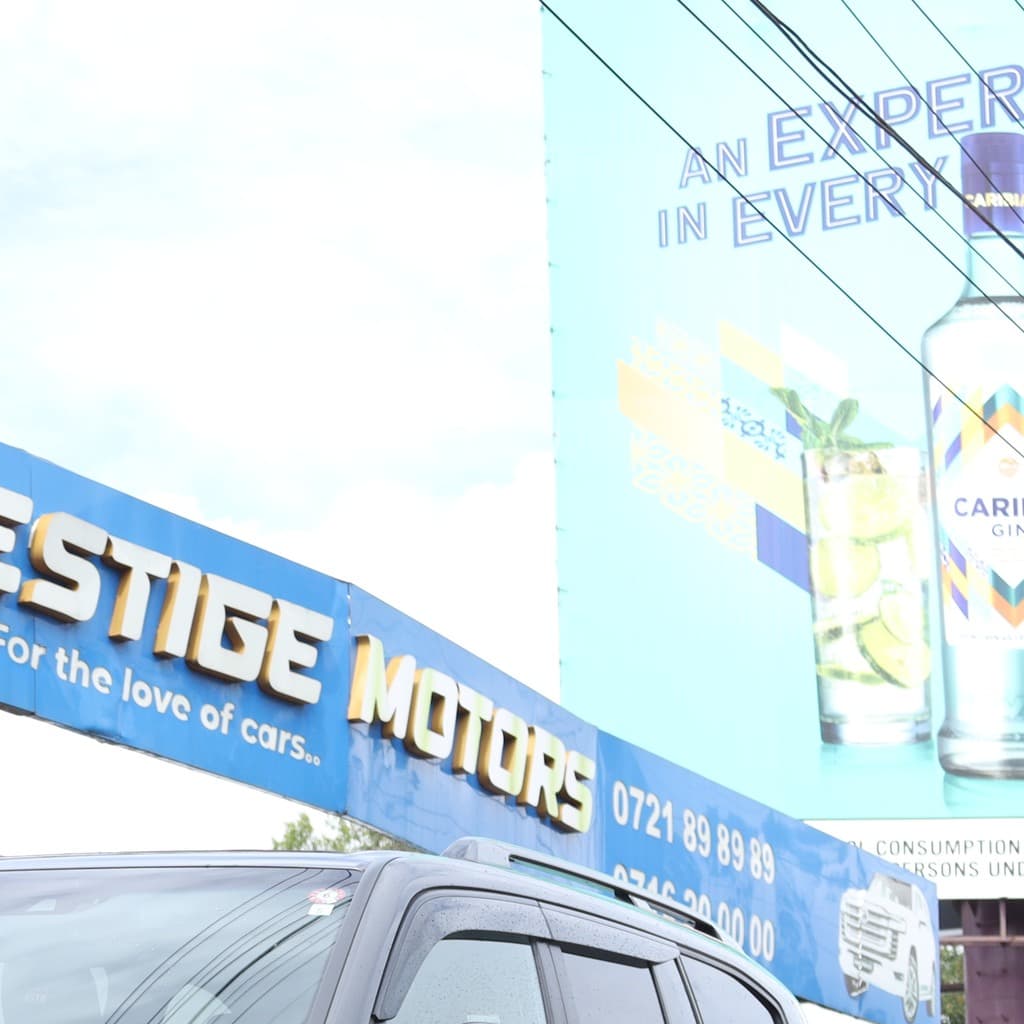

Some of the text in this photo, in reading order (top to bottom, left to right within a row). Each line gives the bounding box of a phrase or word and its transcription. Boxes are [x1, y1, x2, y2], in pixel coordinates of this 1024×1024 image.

[679, 64, 1024, 188] AN EXPER
[658, 156, 949, 248] IN EVERY
[954, 497, 1024, 517] CARI
[992, 523, 1024, 537] GIN
[54, 647, 113, 695] the
[121, 668, 192, 721] love
[199, 702, 235, 735] of
[347, 634, 596, 833] MOTORS
[612, 780, 775, 884] 0721 89 89 89
[876, 839, 1021, 856] CONSUMPTION
[894, 861, 979, 878] RSONS
[750, 914, 775, 962] 00
